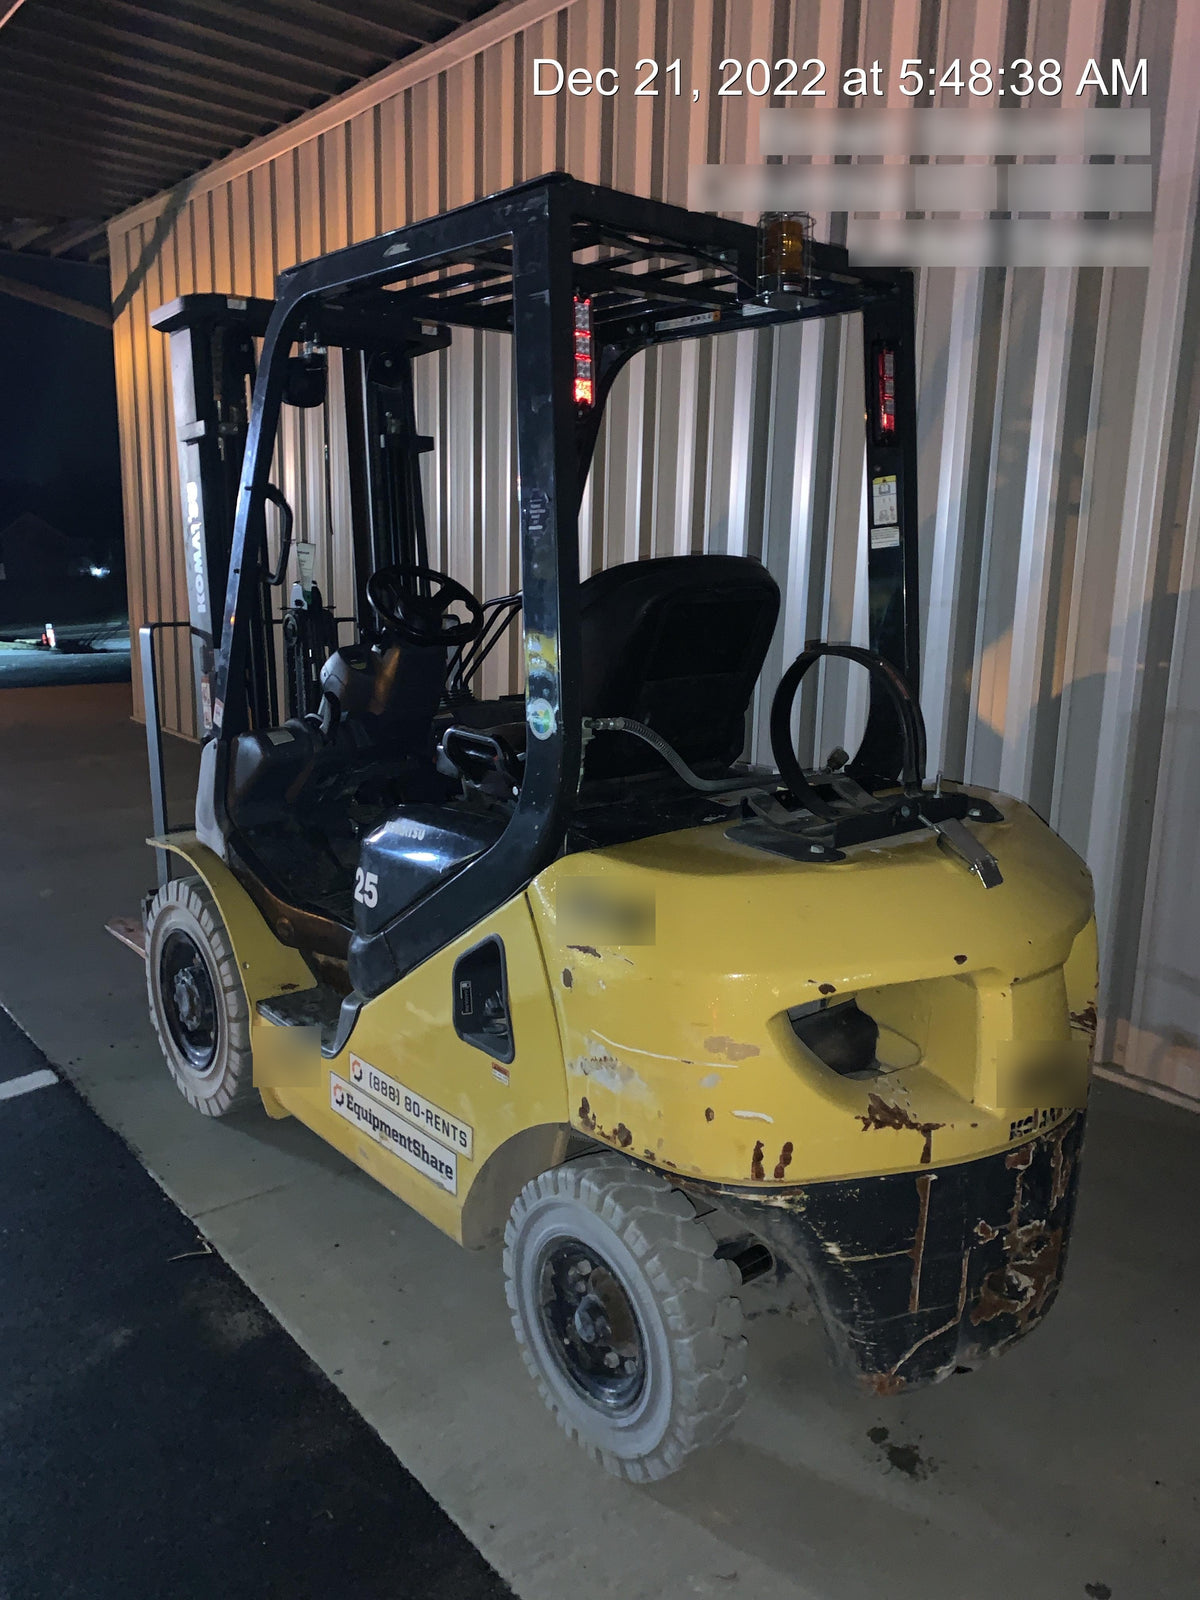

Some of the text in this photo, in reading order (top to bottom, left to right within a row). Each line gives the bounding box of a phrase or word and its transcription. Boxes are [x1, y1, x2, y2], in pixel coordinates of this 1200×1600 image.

[353, 866, 379, 909] 25
[346, 1091, 454, 1181] EquipmentShare
[369, 1071, 468, 1148] (888) 80-RENTS
